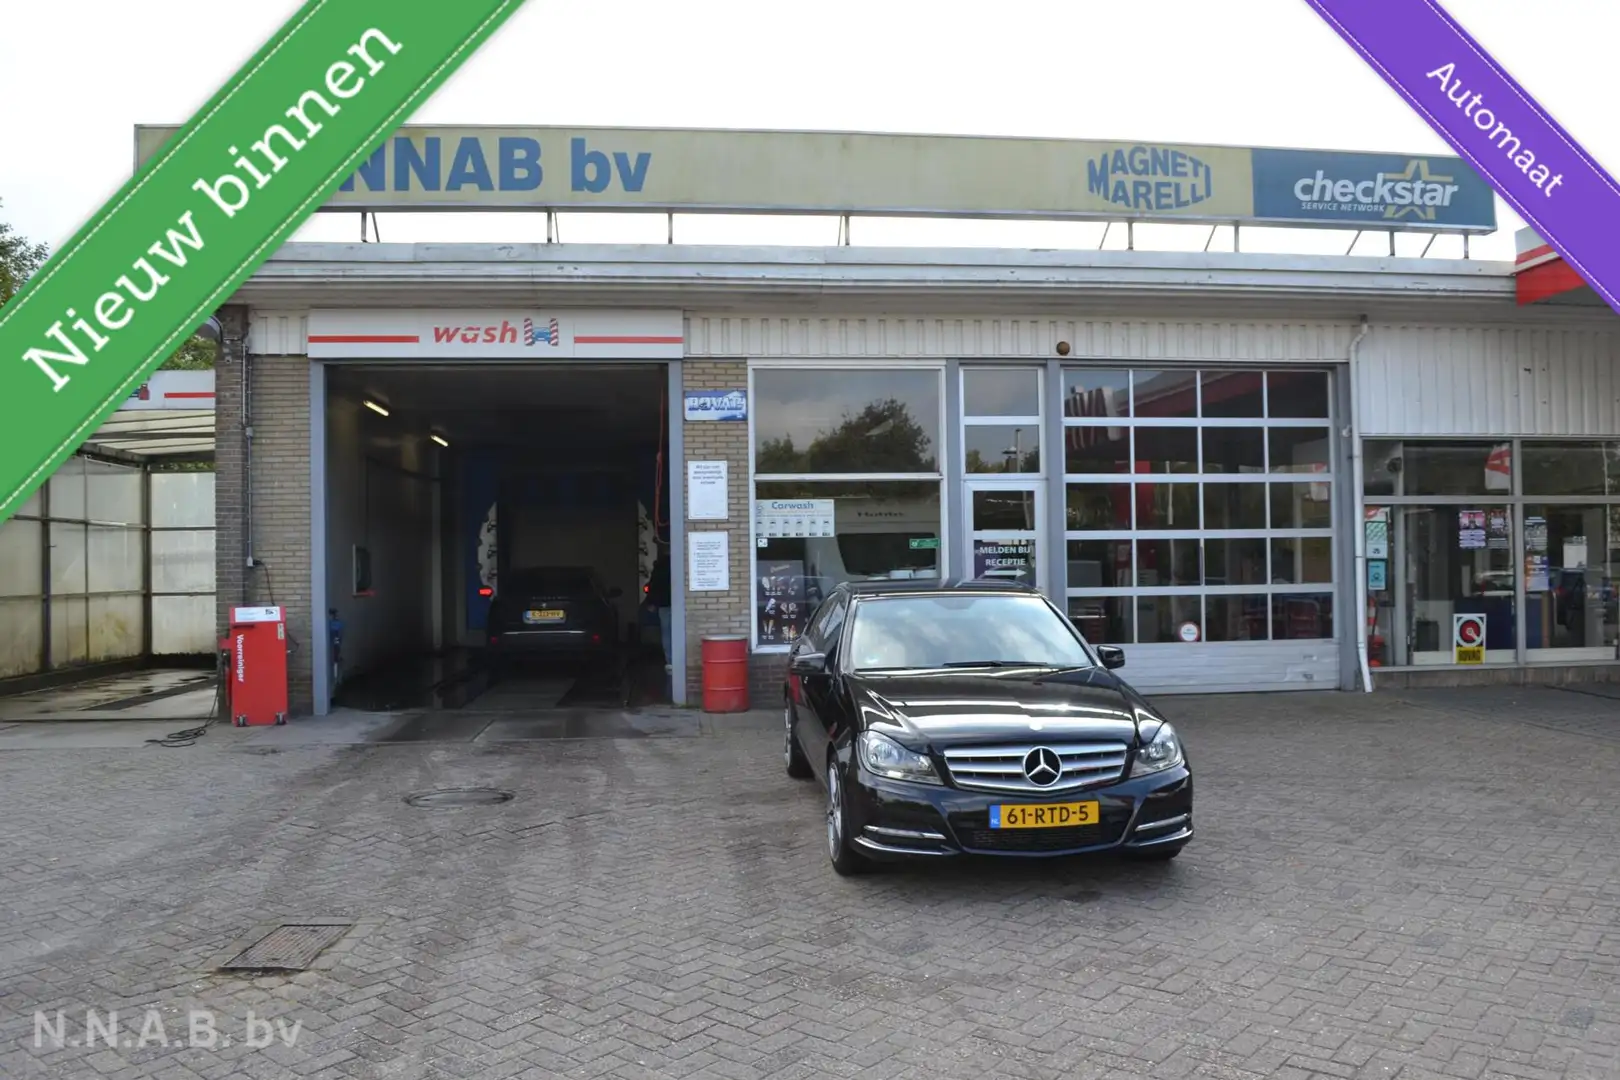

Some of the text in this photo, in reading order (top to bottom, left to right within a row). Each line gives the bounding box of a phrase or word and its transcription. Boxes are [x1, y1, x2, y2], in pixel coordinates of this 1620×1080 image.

[570, 137, 652, 194] bv
[1293, 169, 1460, 207] checkstar
[1301, 202, 1386, 213] SERVICE NETWORK
[432, 320, 518, 344] wash
[771, 501, 815, 511] Carwash
[979, 545, 1015, 555] MELDEN
[985, 558, 1027, 567] RECEPTIE
[1007, 805, 1089, 825] 61-RTD-5
